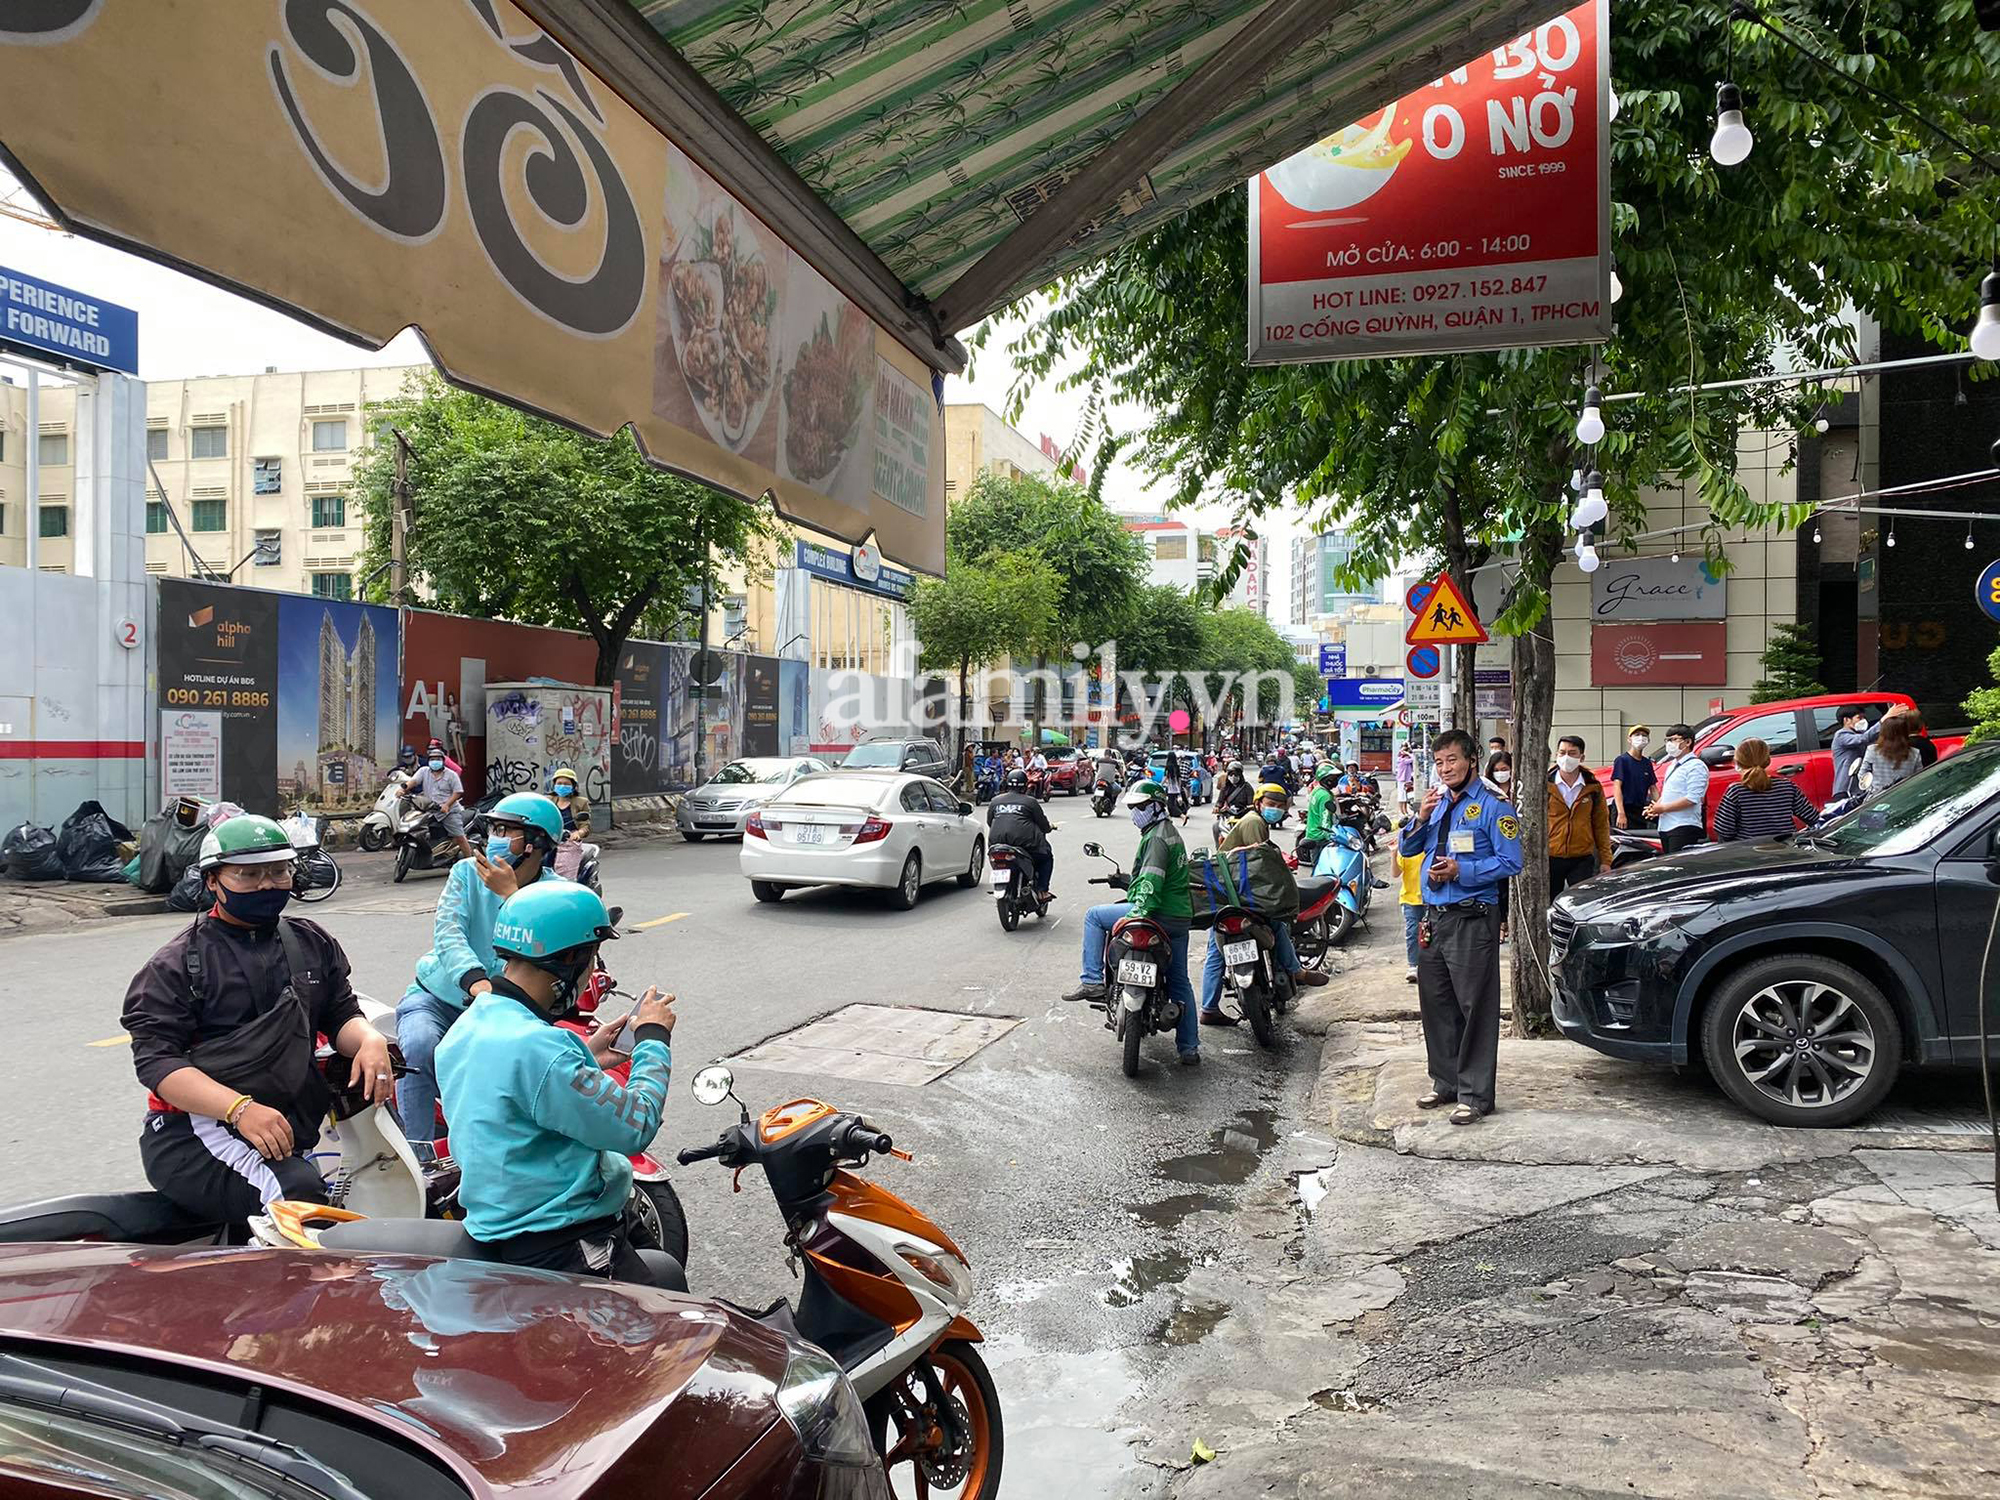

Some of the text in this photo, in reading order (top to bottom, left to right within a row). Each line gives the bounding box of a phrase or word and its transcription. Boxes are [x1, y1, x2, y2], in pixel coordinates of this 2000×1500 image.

[1486, 71, 1577, 156] NỞ
[1499, 162, 1565, 178] SINCE 1999
[1327, 243, 1360, 267] MỞ
[1366, 240, 1414, 264] CỬA:
[1421, 241, 1459, 259] 6:00
[1481, 234, 1530, 253] 14:00
[1313, 275, 1547, 310] HOT LINE: 0927.152.847
[1266, 301, 1599, 341] 102 CỐNG QUỲNH, QUẬN 1, TPHCM
[8, 307, 109, 357] FORWARD
[1597, 574, 1692, 615] Grace
[125, 623, 136, 643] 2
[217, 621, 251, 635] alpha
[217, 635, 235, 648] hill
[184, 674, 215, 684] HOTLINE
[217, 675, 229, 685] DỰ
[229, 674, 240, 684] ÁN
[167, 688, 269, 706] 090 261 8886
[1362, 685, 1401, 695] Pharmacity
